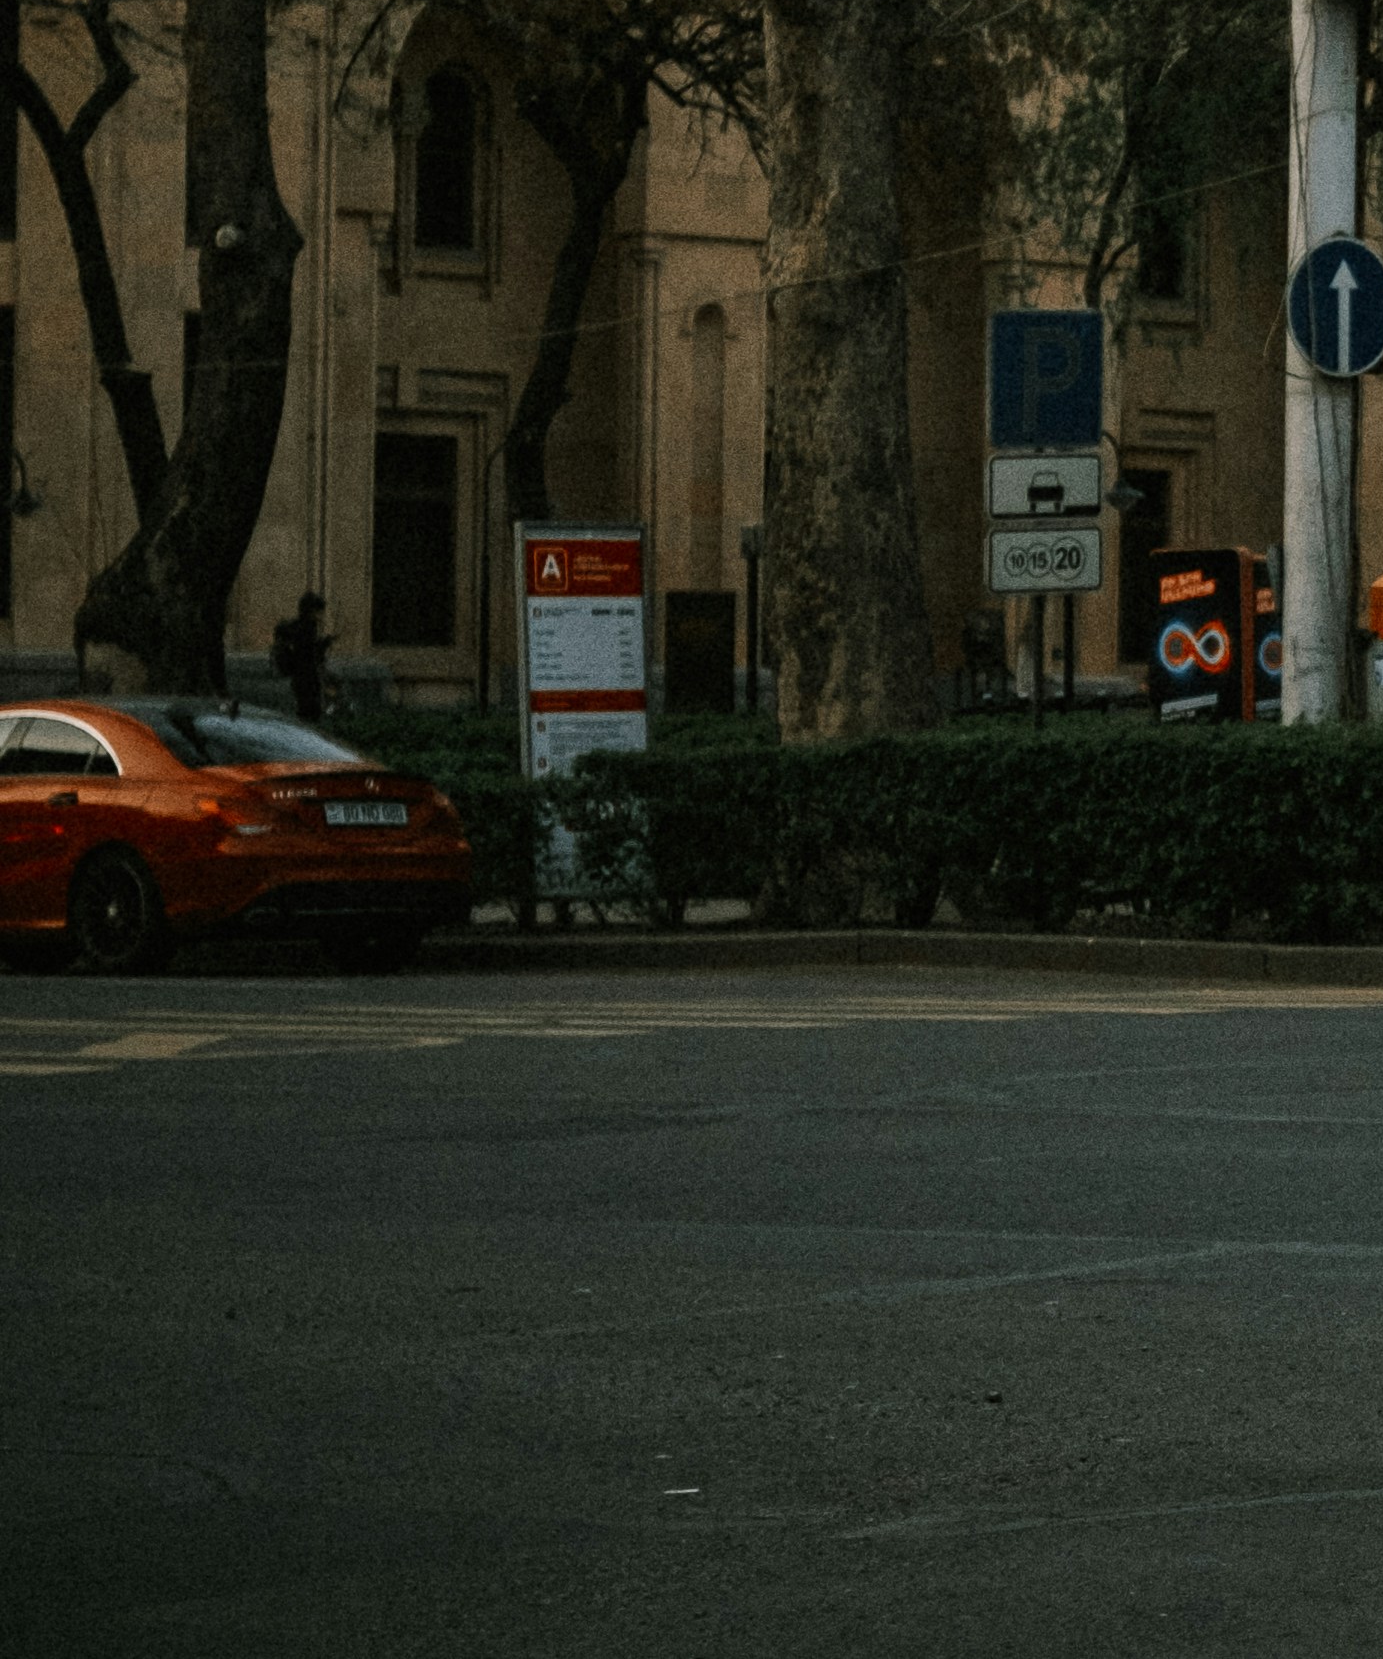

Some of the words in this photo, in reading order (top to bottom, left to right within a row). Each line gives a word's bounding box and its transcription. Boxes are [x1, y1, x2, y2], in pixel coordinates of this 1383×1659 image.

[1023, 325, 1083, 432] P
[540, 553, 562, 579] A
[1011, 553, 1025, 567] 10
[1030, 551, 1048, 568] 15
[1055, 547, 1080, 570] 20
